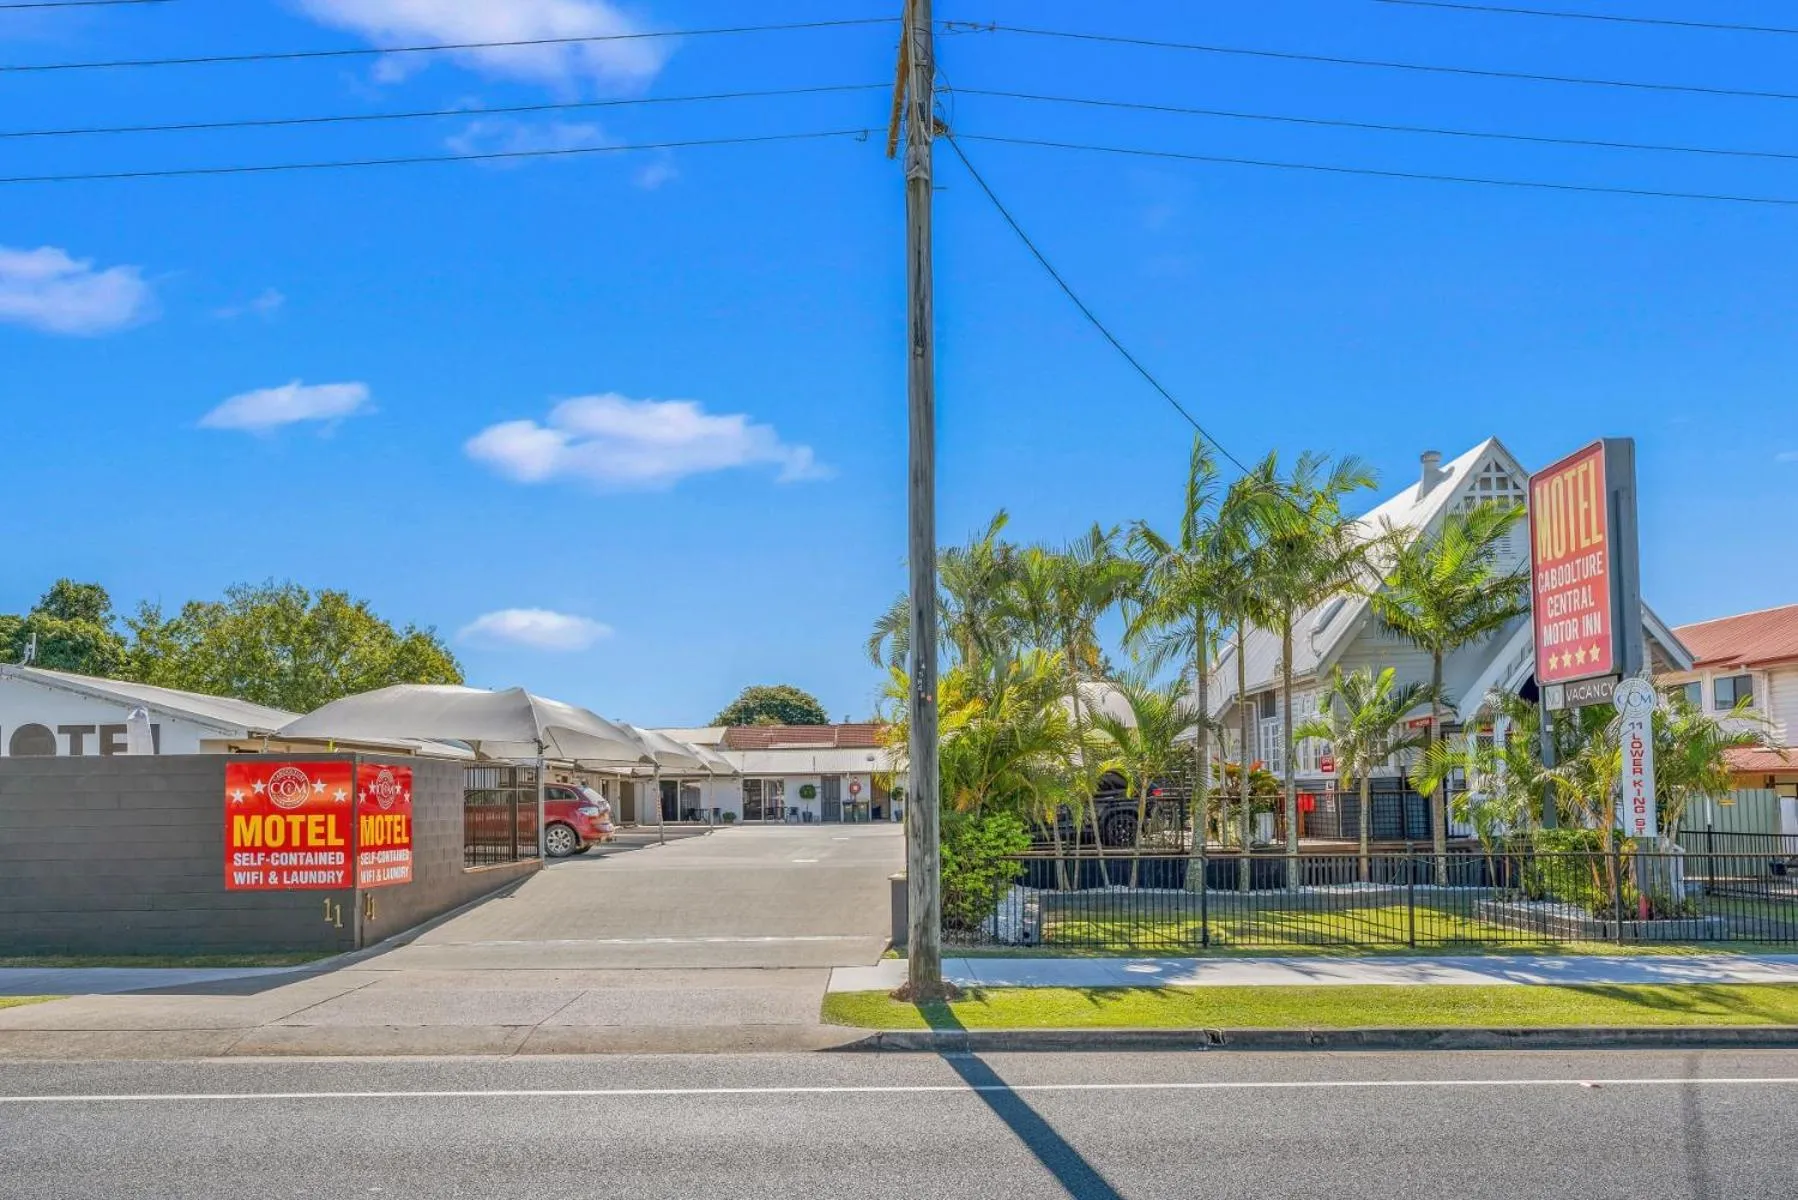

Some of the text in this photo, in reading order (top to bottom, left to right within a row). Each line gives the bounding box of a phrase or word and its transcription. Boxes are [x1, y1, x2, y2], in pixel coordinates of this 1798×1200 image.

[1535, 459, 1603, 564] MOTEL
[1538, 551, 1604, 593] CABOOLTURE
[1547, 586, 1594, 617] CENTRAL
[1543, 611, 1601, 648] MOTOR INN
[1566, 682, 1615, 702] VACANCY
[1630, 733, 1644, 776] LOWER
[1633, 780, 1646, 814] KING
[233, 814, 345, 848] MOTEL
[360, 814, 410, 847] MOTEL
[1635, 818, 1646, 835] ST
[233, 852, 344, 866] SELF-CONTAINED
[360, 849, 410, 866] SELF-CONTAINED
[233, 870, 344, 885] WIFI & LAUNDRY
[360, 866, 409, 884] WIFI & LAUNDRY
[323, 898, 344, 928] 11
